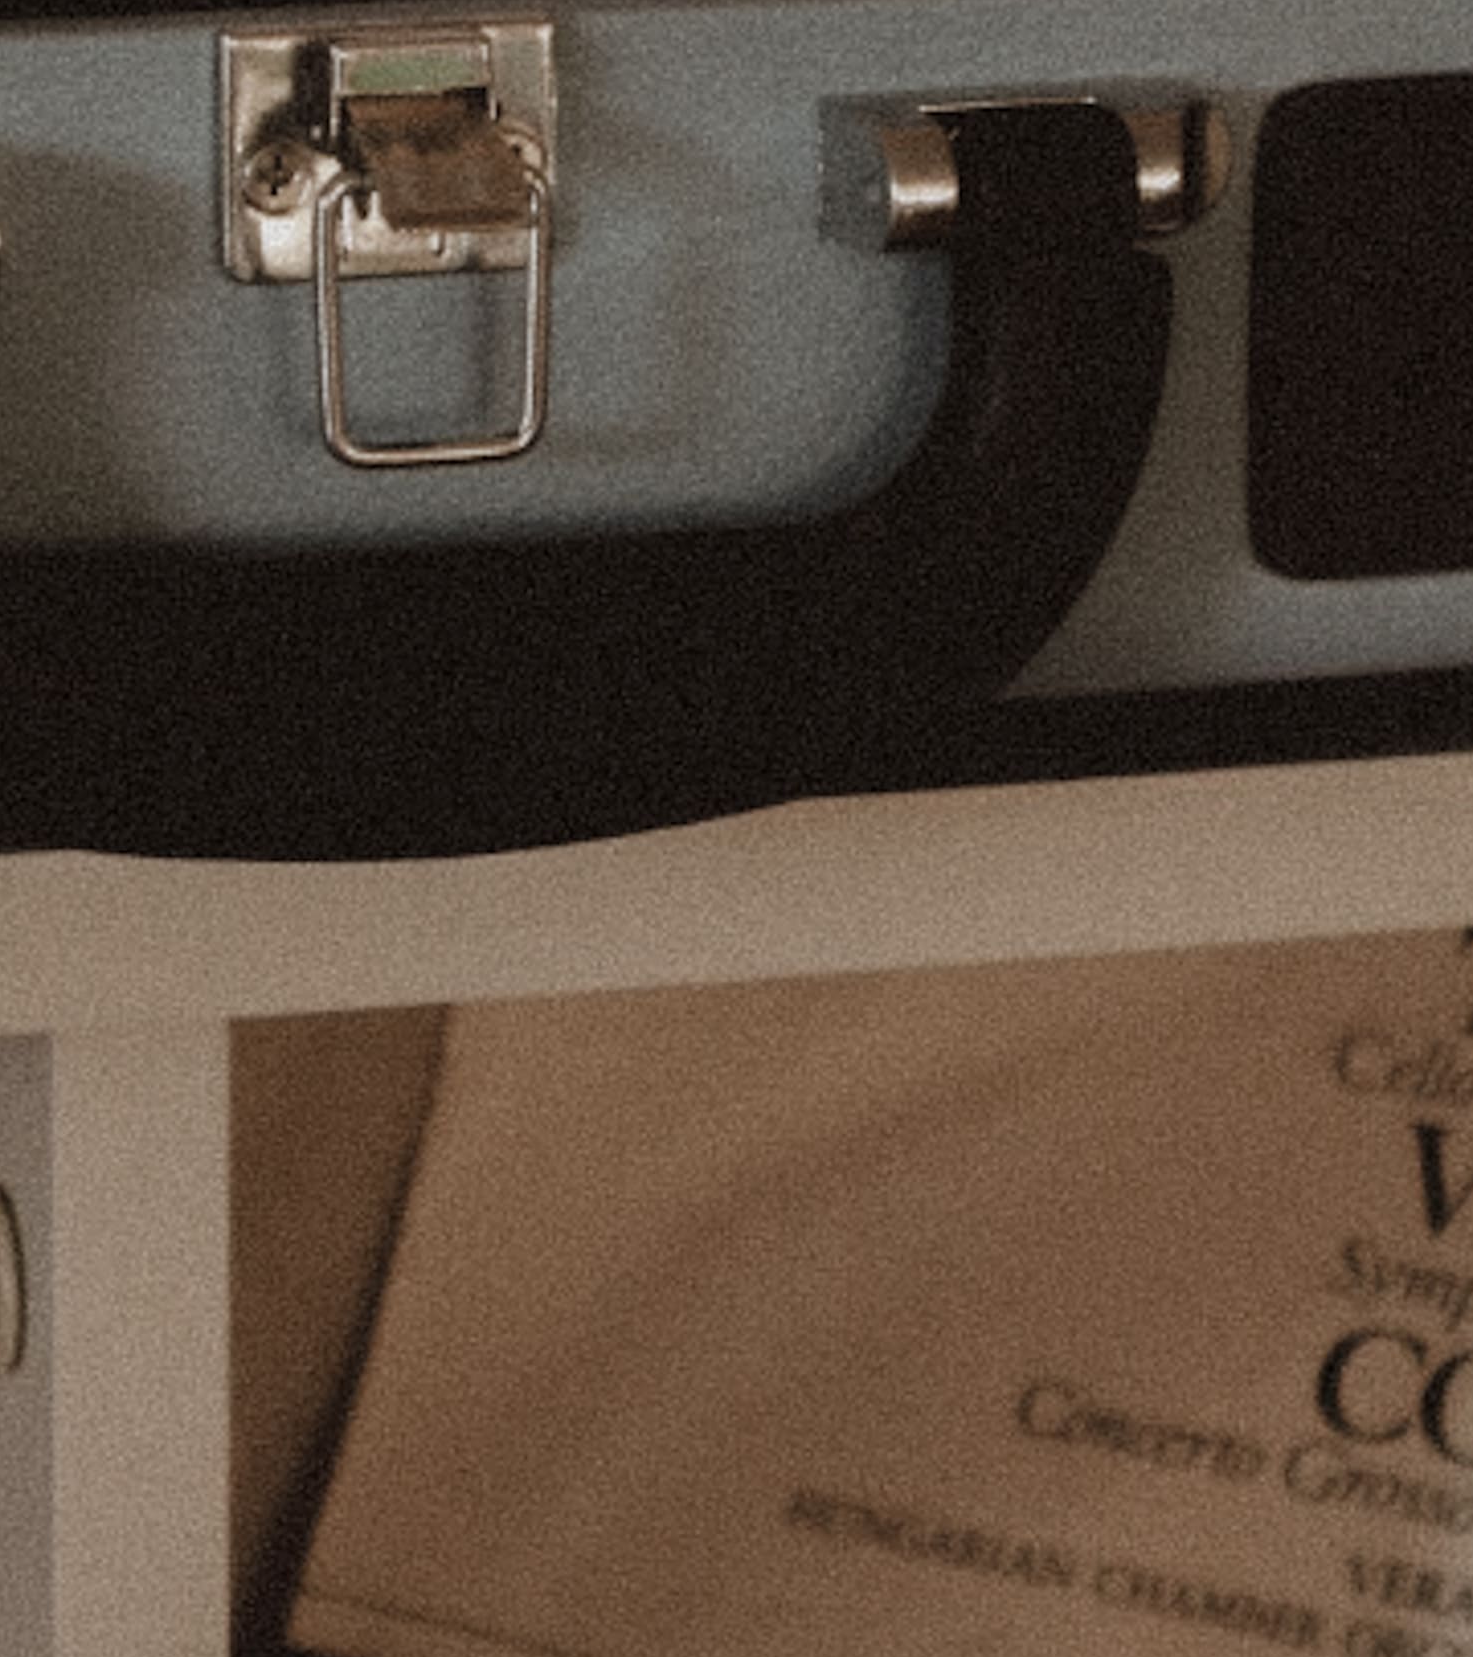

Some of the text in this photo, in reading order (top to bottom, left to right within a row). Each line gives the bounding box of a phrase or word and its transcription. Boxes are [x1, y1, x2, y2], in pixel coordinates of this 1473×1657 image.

[1014, 1378, 1268, 1482] Concerto
[784, 1488, 1078, 1590] HUNGARIAN
[1090, 1562, 1330, 1654] CHAMBER
